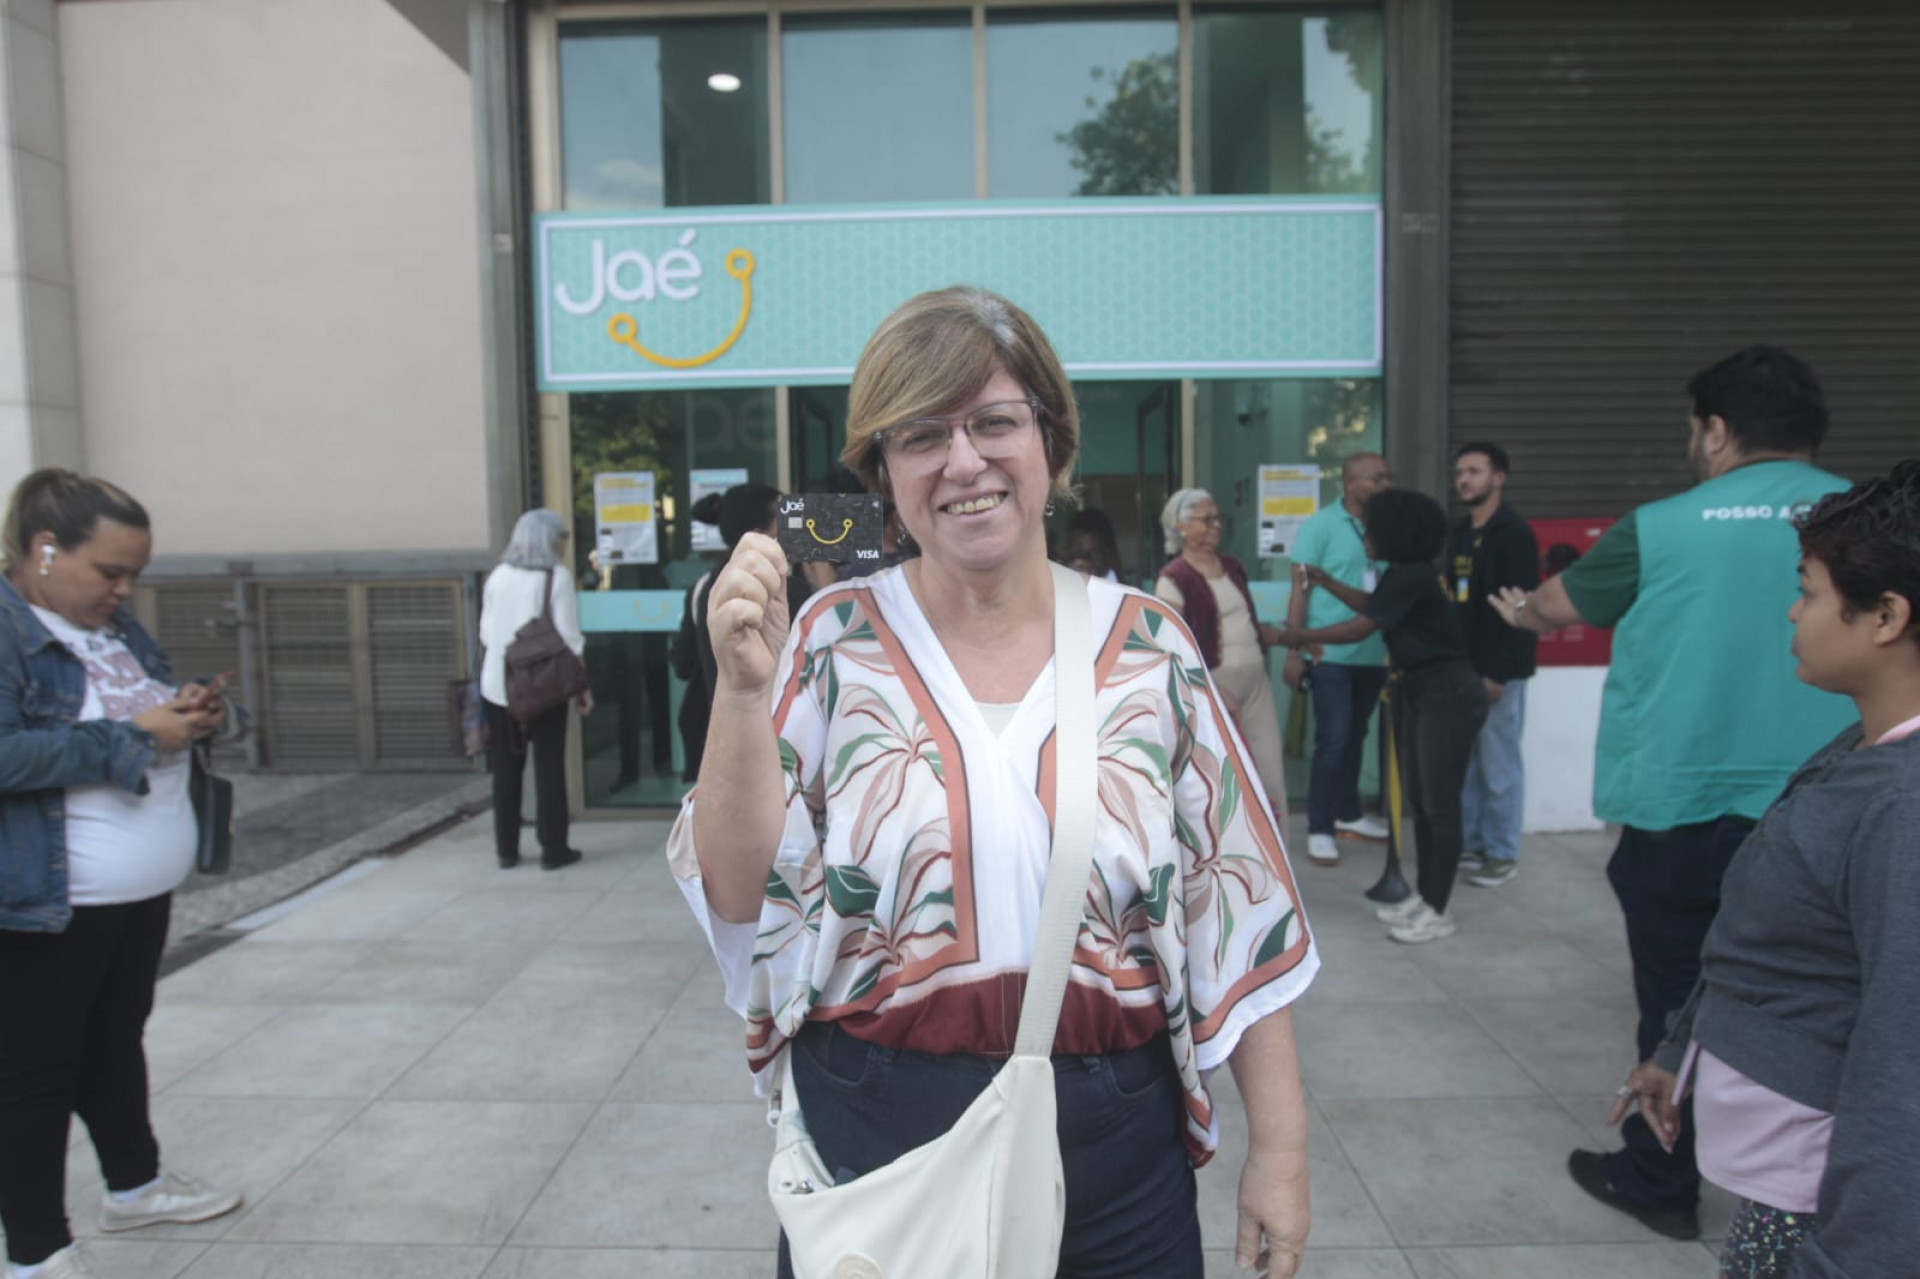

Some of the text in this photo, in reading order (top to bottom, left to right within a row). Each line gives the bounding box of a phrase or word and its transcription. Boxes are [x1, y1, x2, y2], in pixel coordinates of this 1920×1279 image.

[555, 228, 702, 315] Jaé
[1702, 504, 1773, 521] POSSO
[856, 549, 880, 560] VISA
